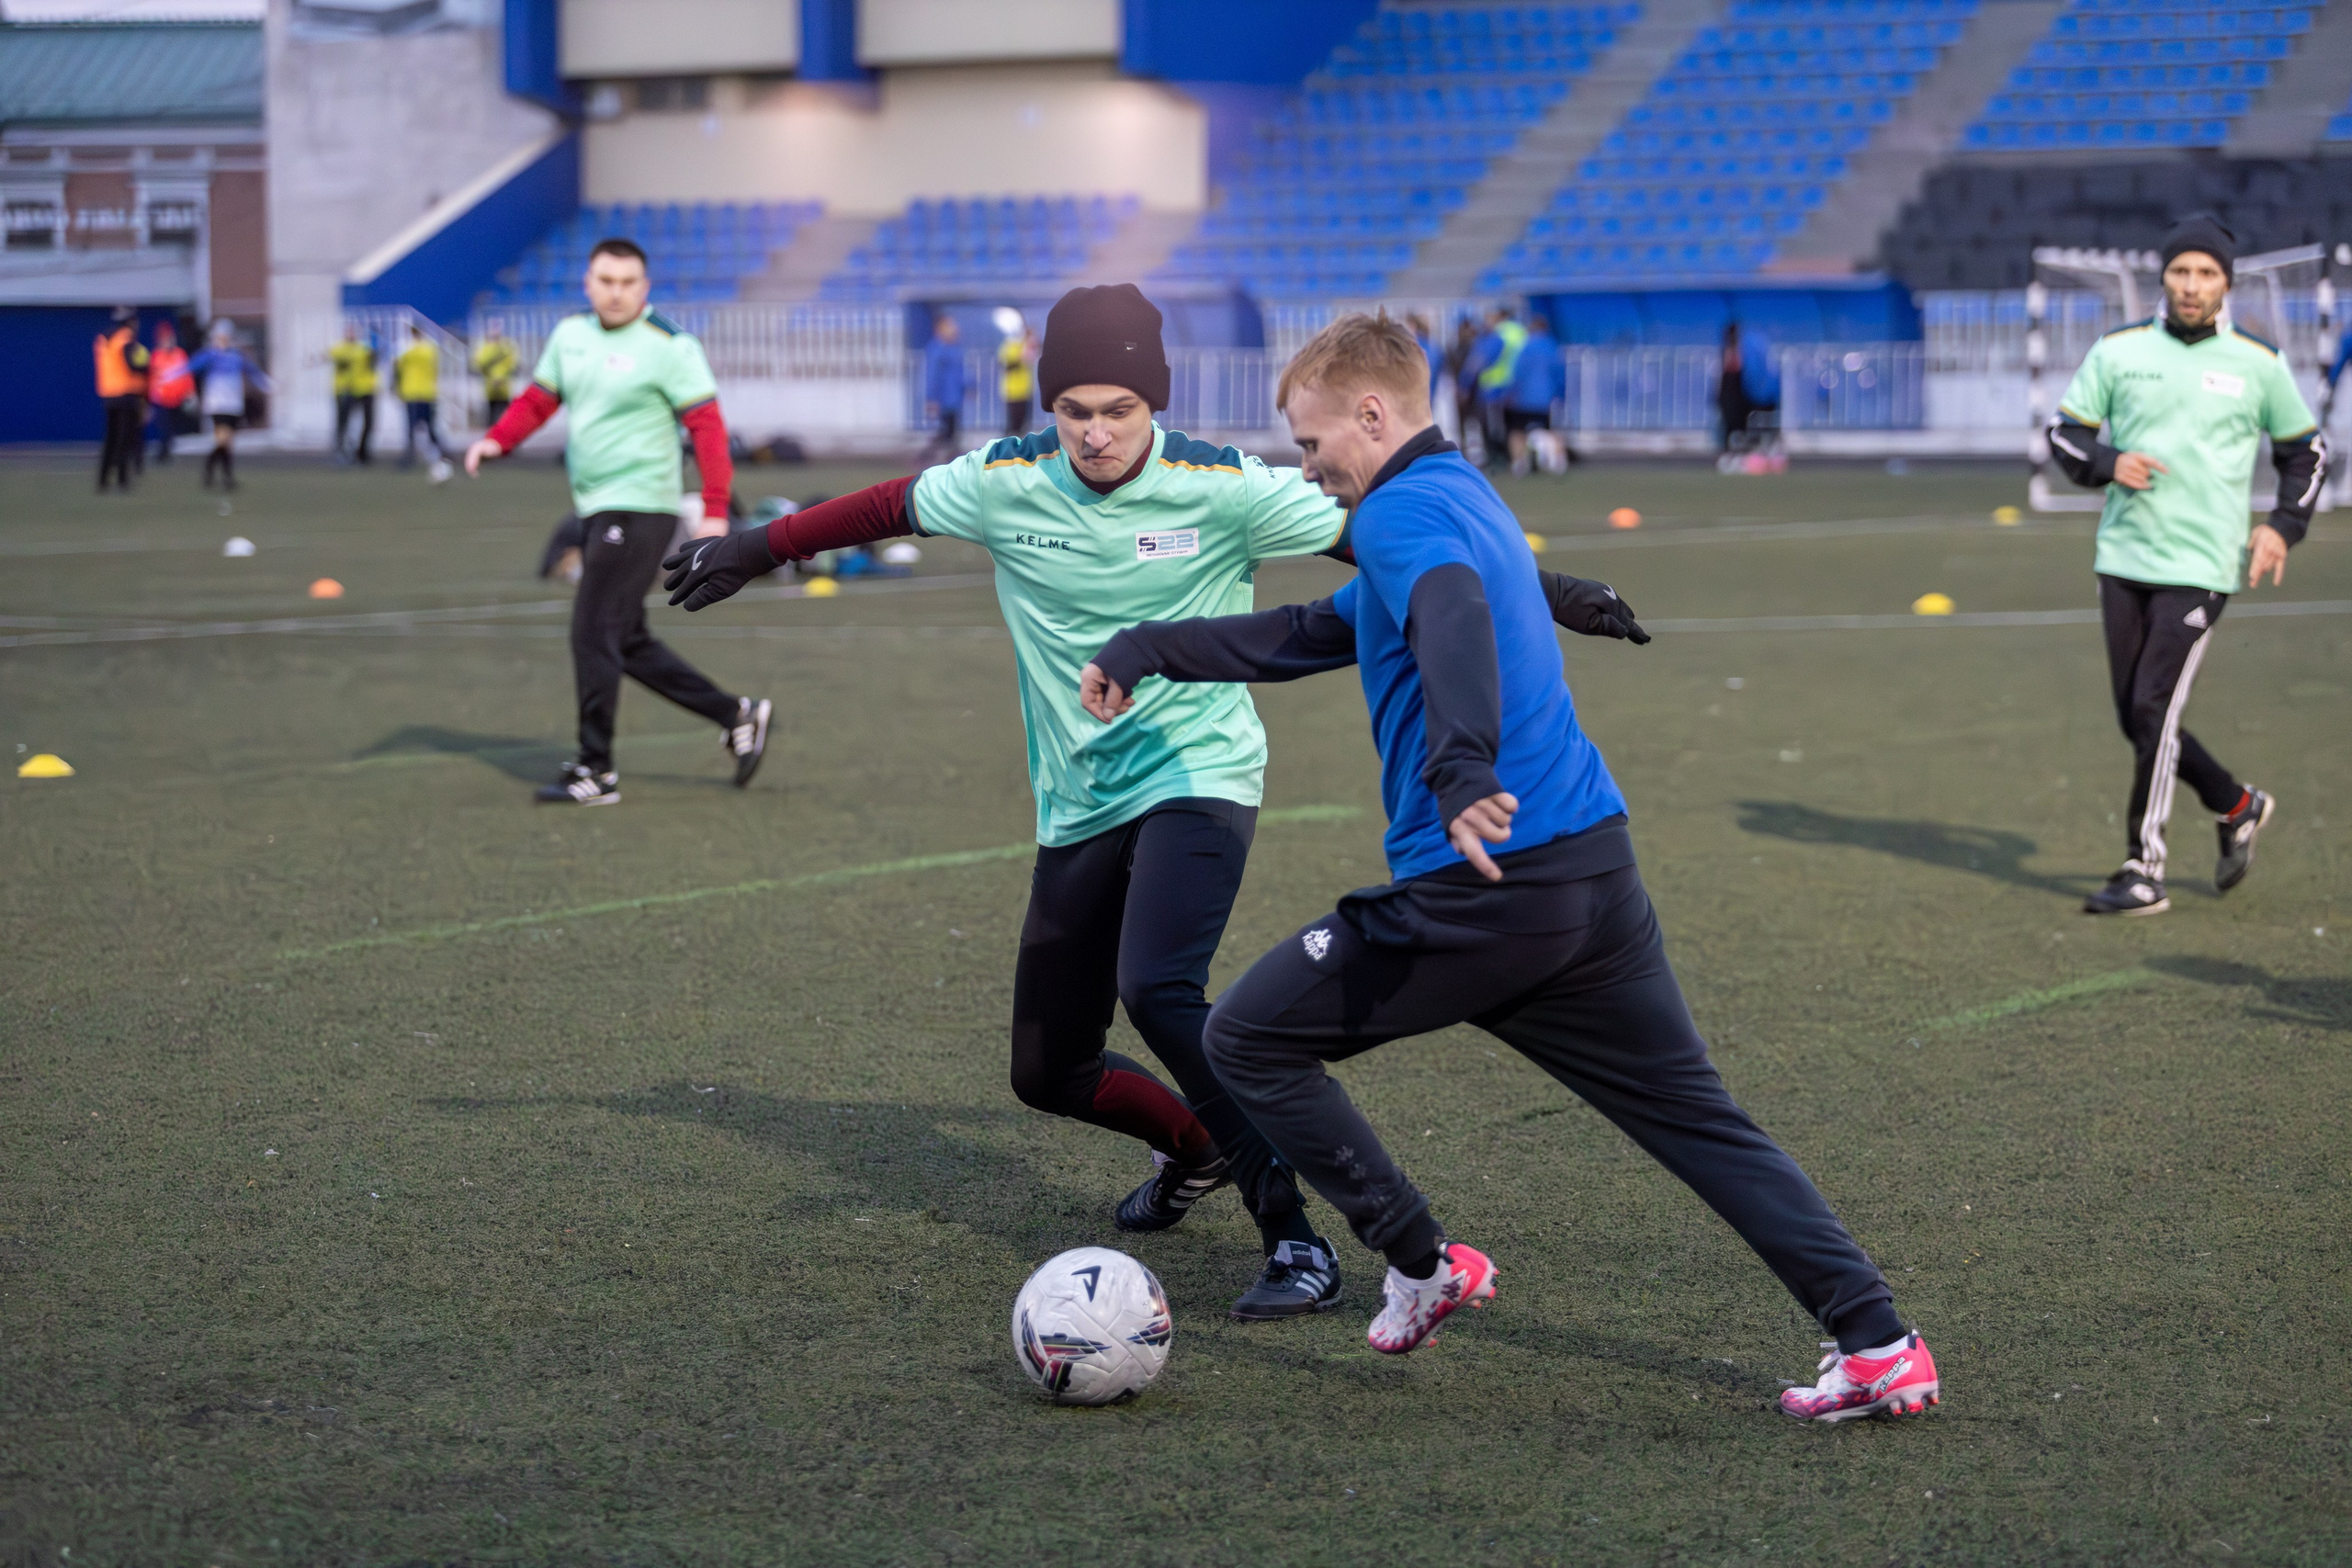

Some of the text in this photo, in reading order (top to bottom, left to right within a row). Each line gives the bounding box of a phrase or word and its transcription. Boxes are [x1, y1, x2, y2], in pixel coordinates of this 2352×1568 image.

[1016, 533, 1070, 550] KELME
[1138, 533, 1194, 552] S22
[1879, 1356, 1906, 1392] Kappa
